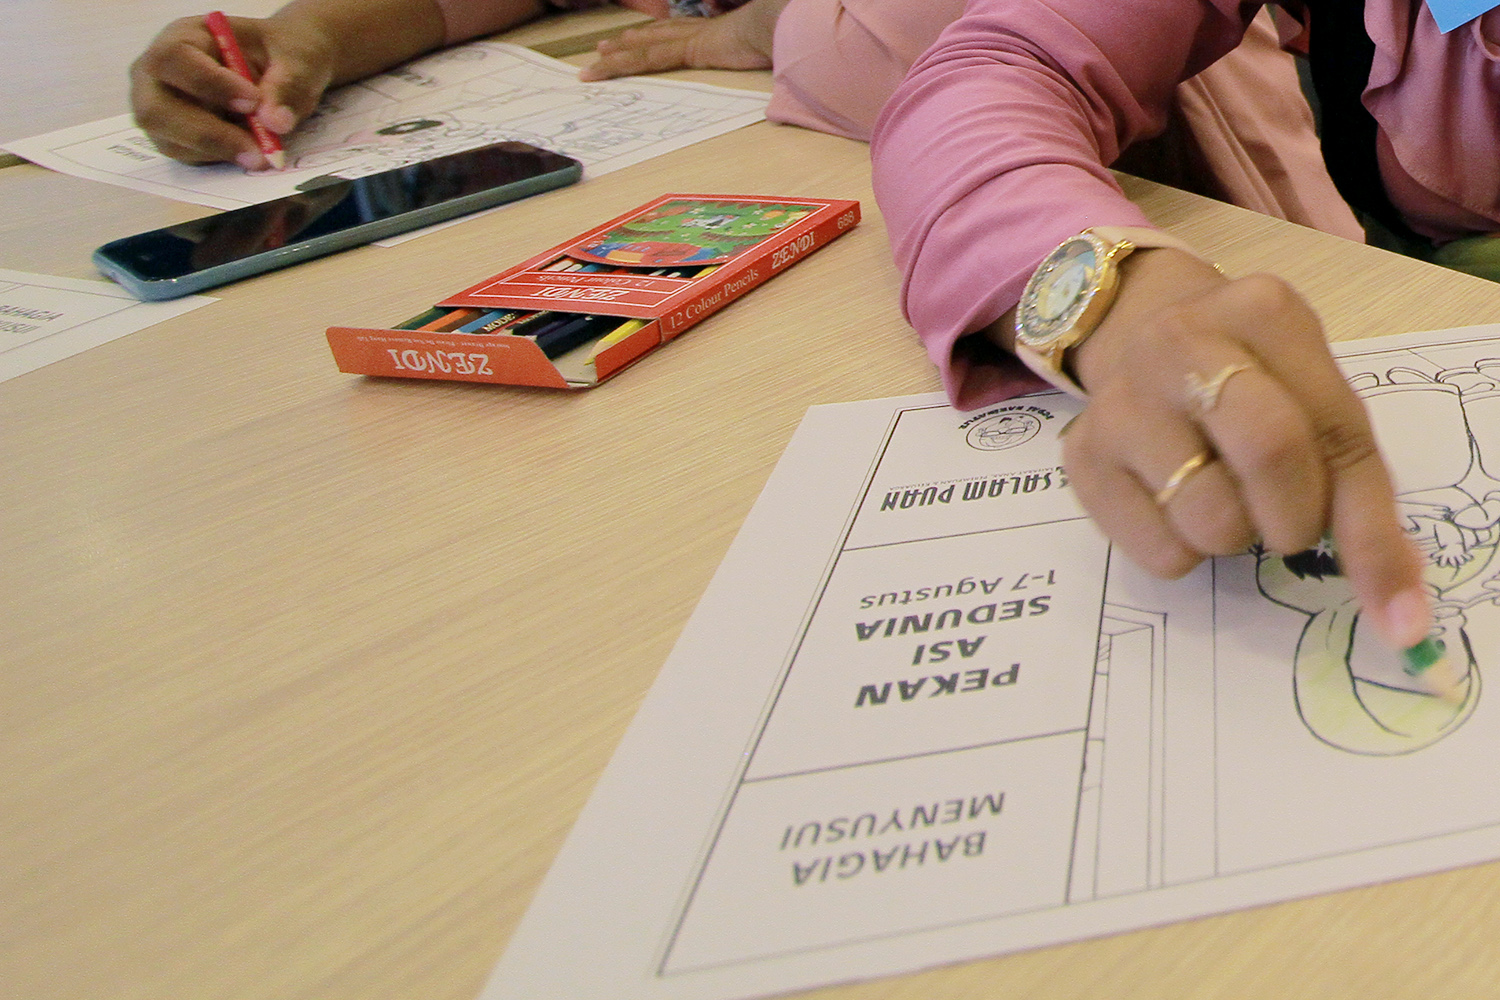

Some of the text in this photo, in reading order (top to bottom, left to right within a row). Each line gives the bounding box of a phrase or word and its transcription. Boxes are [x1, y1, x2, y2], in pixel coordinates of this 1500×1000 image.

[771, 232, 816, 269] ZENDI
[531, 285, 631, 302] ZENDI
[670, 268, 760, 330] 12 Colour Pencils
[387, 349, 494, 376] ZENDI
[879, 472, 1053, 513] SALAM PUAN
[859, 568, 1057, 610] 1-7 Agustus
[854, 594, 1052, 642] SEDUNIA
[911, 634, 987, 666] ASI
[854, 662, 1021, 709] PEKAN
[779, 791, 1006, 851] MENYUSUI
[791, 830, 988, 887] BAHAGIA
